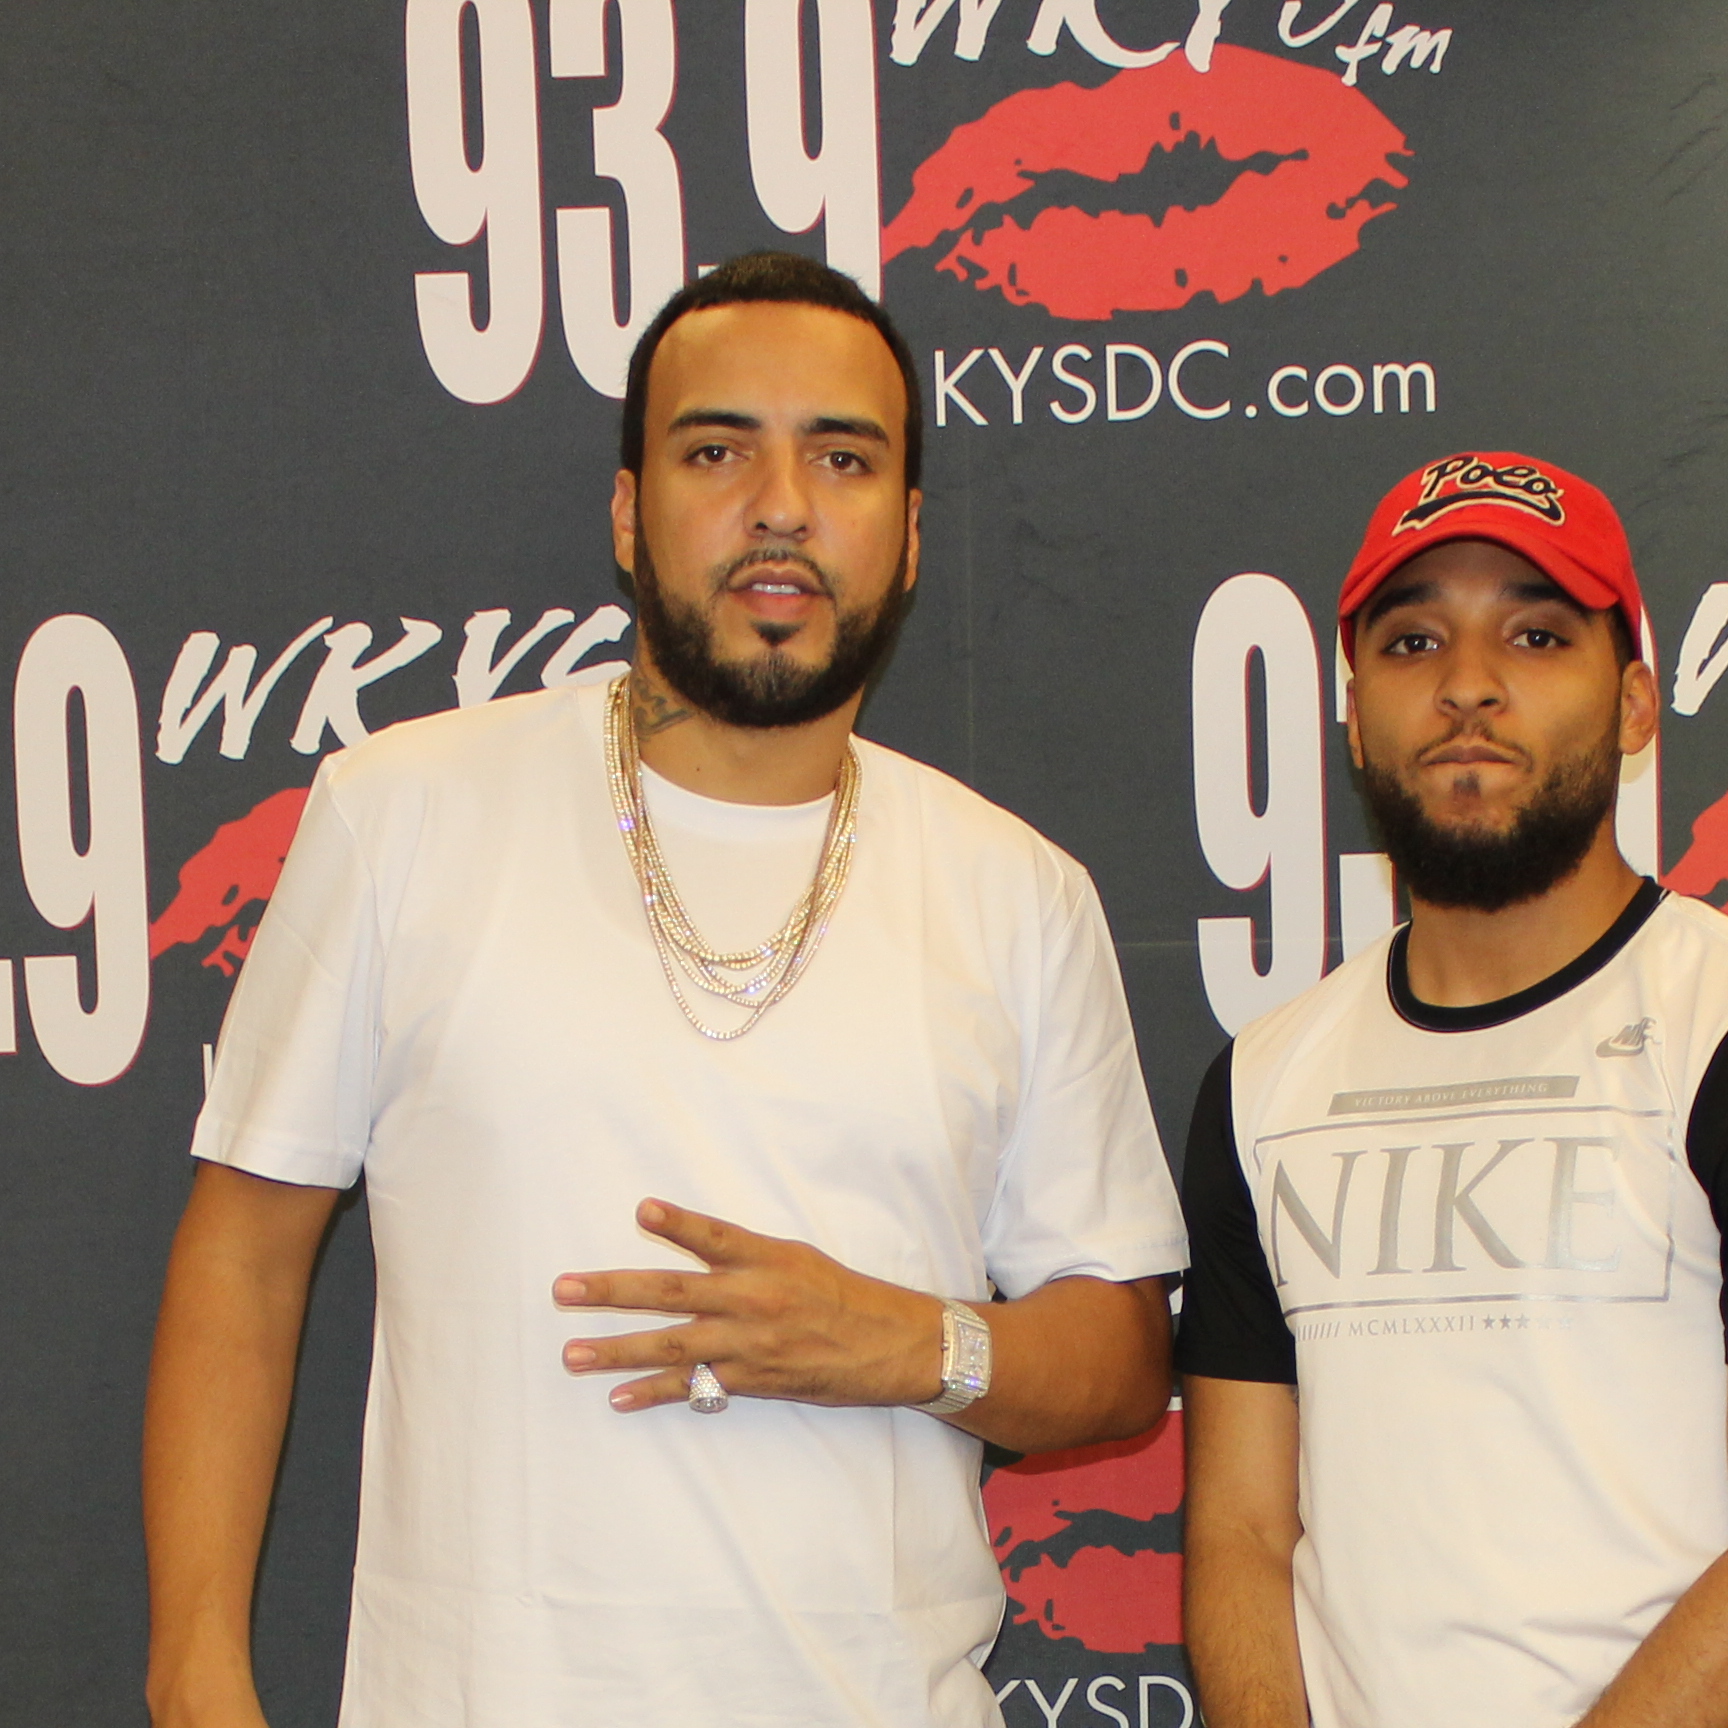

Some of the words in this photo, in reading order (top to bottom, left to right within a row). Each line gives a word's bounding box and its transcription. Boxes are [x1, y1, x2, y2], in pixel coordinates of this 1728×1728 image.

[404, 0, 884, 404] 939
[933, 340, 1438, 428] KYSDC.com
[1354, 1093, 1410, 1107] VICTORY
[1415, 1091, 1456, 1103] ABOVE
[1271, 1135, 1623, 1289] NIKE
